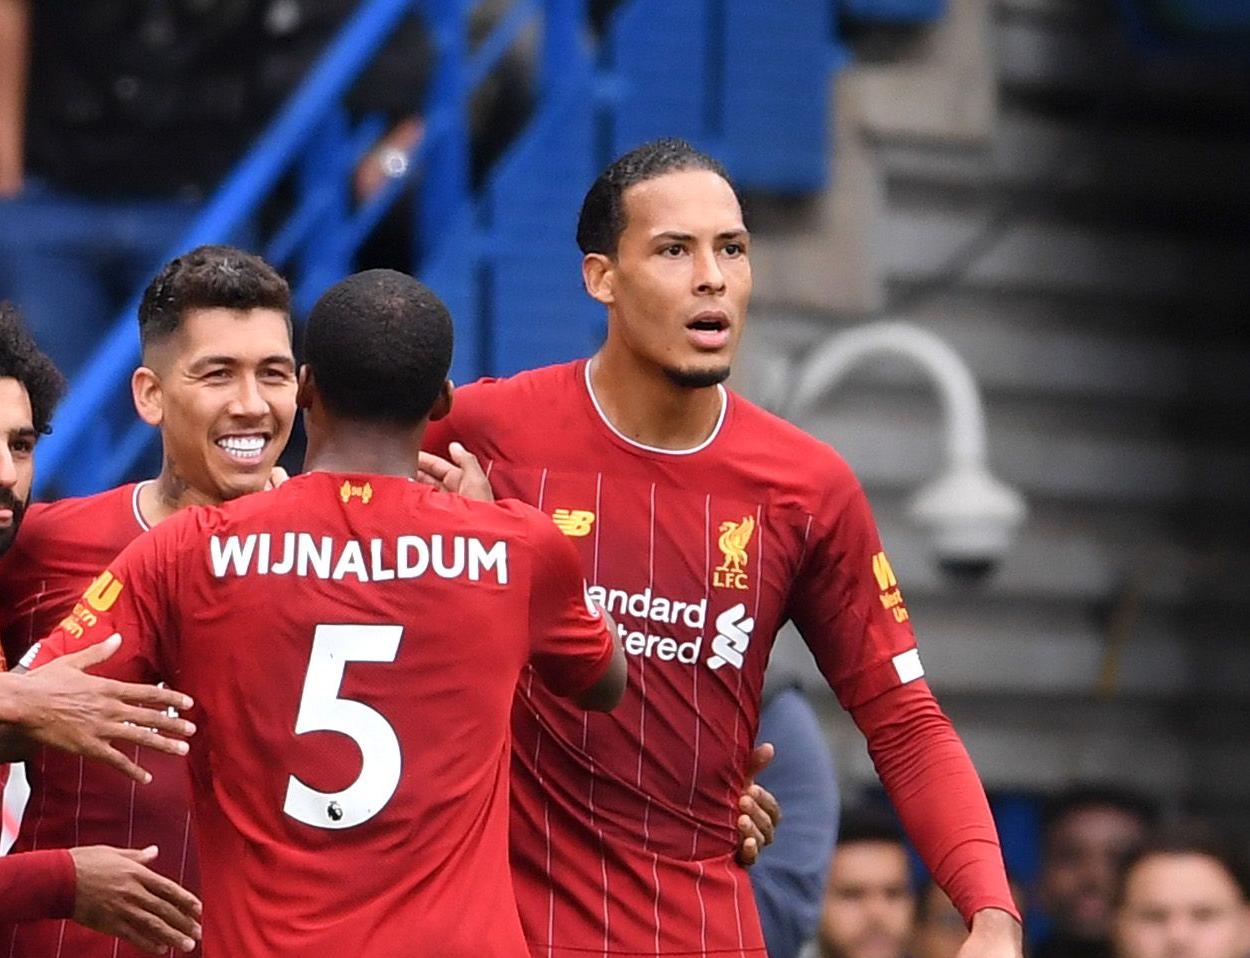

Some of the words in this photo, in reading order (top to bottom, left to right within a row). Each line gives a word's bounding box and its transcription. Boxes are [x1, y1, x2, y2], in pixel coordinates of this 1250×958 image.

[210, 532, 508, 585] WIJNALDUM
[588, 585, 708, 629] andard
[617, 623, 703, 664] tered
[282, 624, 405, 830] 5
